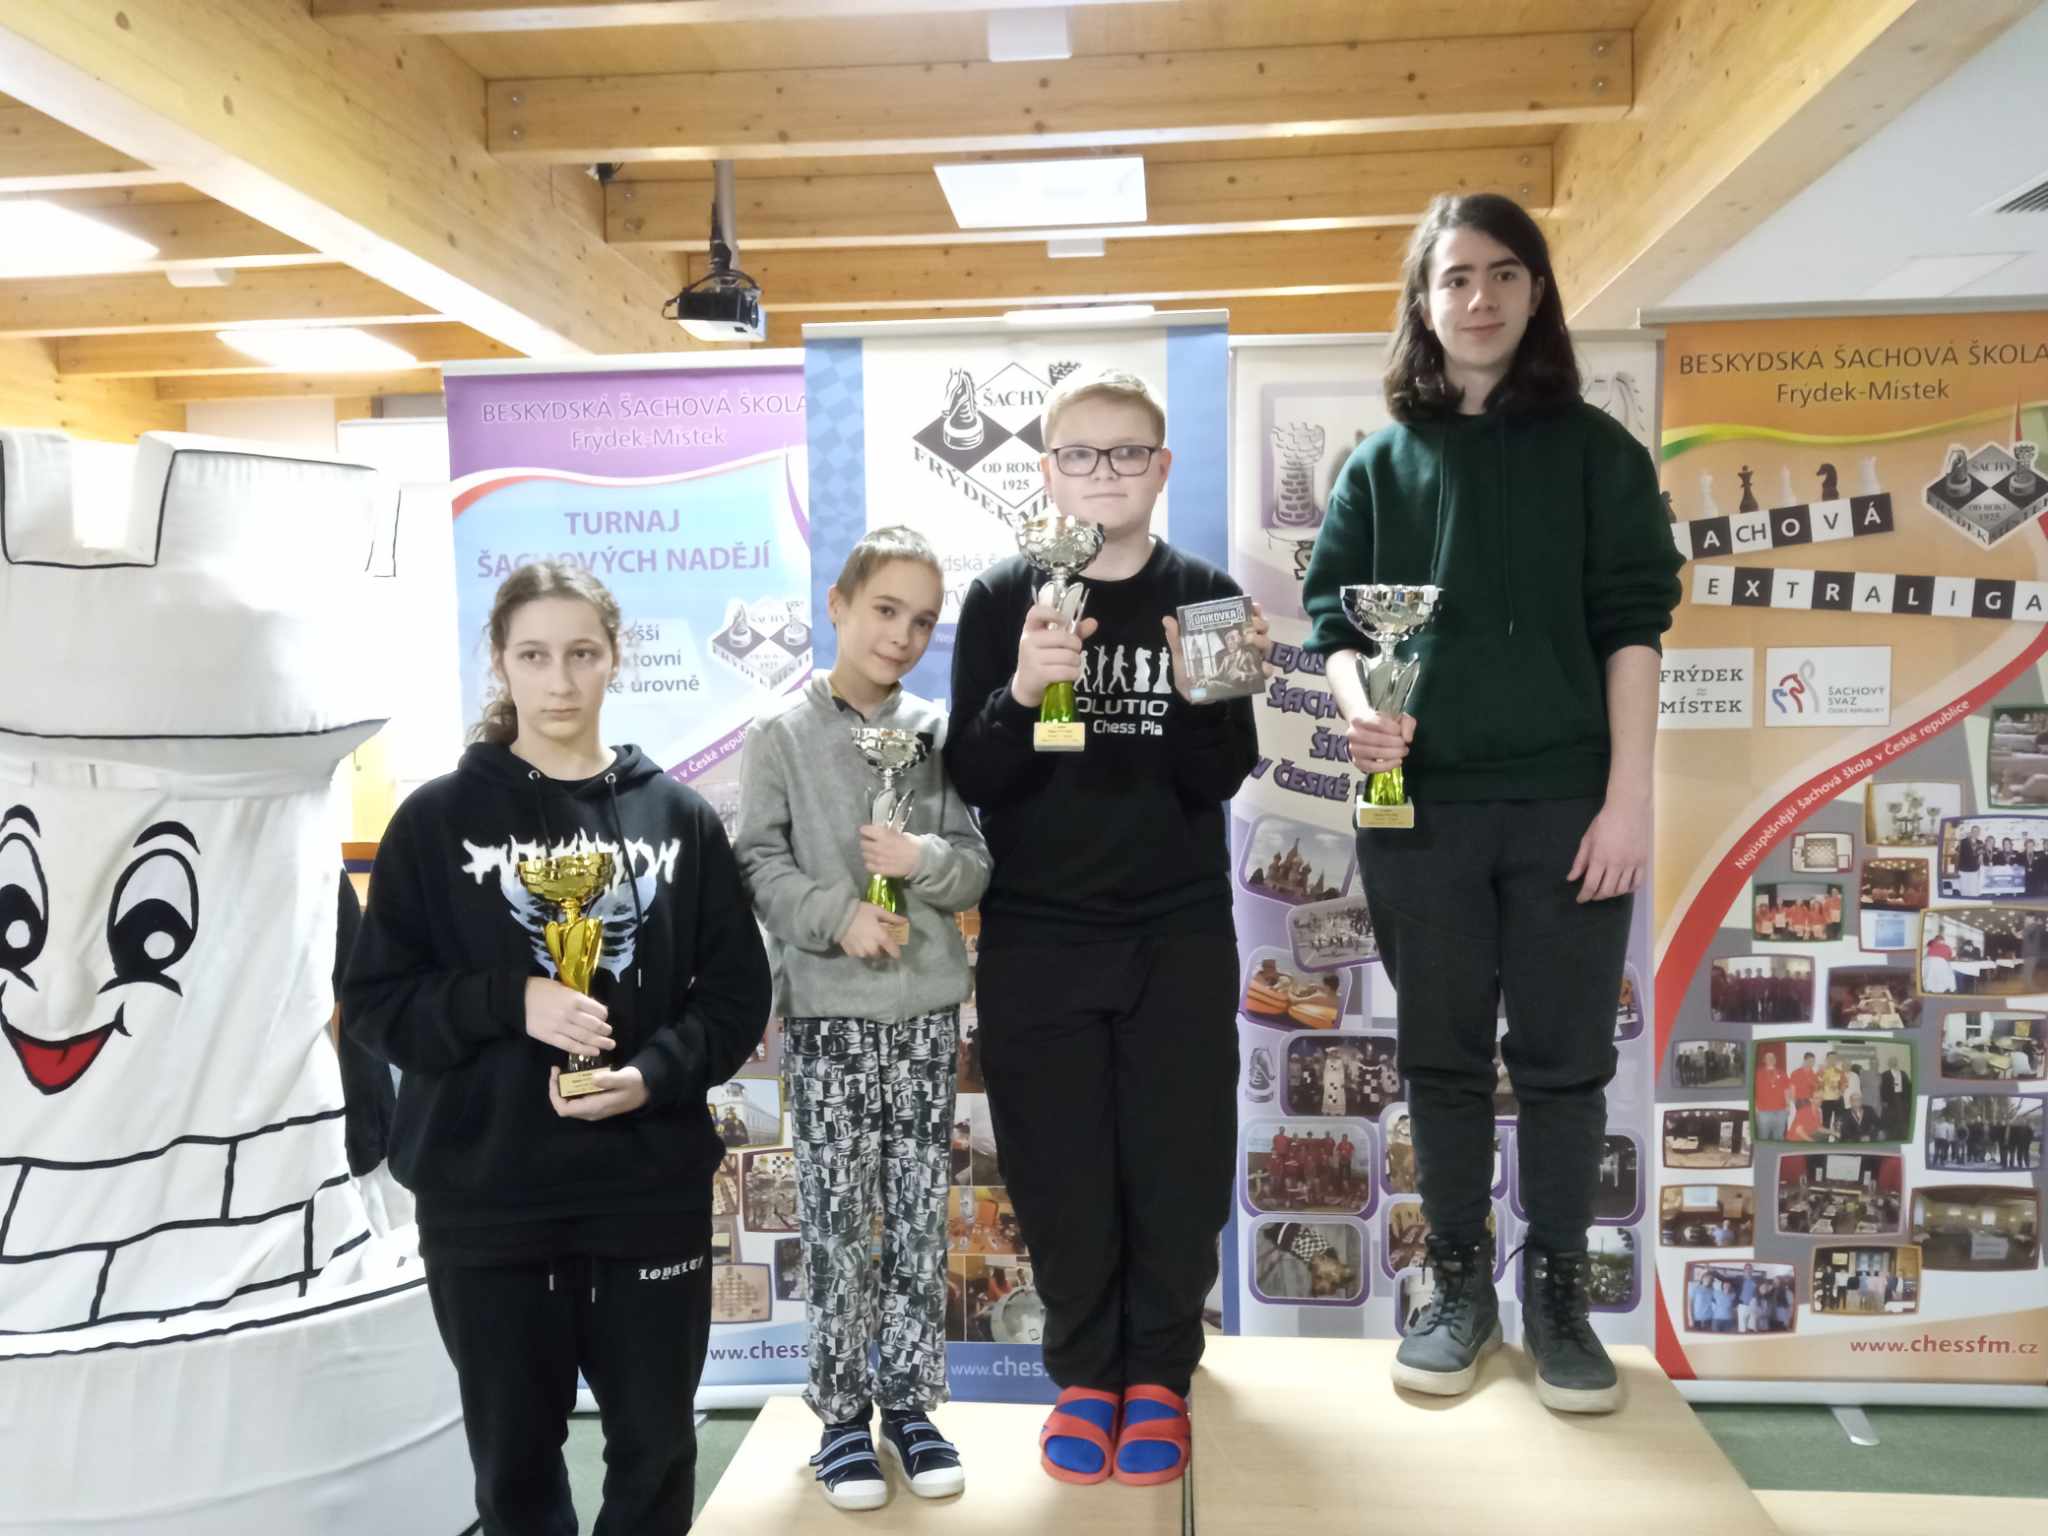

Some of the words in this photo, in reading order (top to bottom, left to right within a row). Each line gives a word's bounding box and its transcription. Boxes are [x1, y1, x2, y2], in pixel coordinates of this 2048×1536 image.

[1679, 347, 1825, 376] BESKYDSKÁ
[1833, 340, 1960, 370] ŠACHOVÁ
[1967, 338, 2048, 366] ŠKOLA
[982, 387, 1048, 408] ŠACHY
[1776, 378, 1951, 409] Frýdek-Místek
[619, 391, 733, 420] ŠACHOVÁ
[982, 462, 1002, 474] OD
[1002, 479, 1030, 491] 1925
[564, 509, 681, 536] TURNAJ
[1703, 502, 1884, 550] ACHOVÁ
[666, 541, 771, 572] NADĚJÍ
[1707, 577, 2044, 613] EXTRALIGA
[1660, 664, 1745, 683] FRÝDEK
[1075, 696, 1169, 717] OLUTIO
[1660, 696, 1743, 714] MÍSTEK
[1827, 696, 1857, 706] SVAZ
[1093, 719, 1137, 735] Chess
[1140, 720, 1164, 736] Pla
[1842, 758, 1874, 781] škola
[1875, 752, 1884, 763] v
[1919, 699, 1971, 738] republice
[1273, 758, 1350, 803] ČESKÉ
[710, 1339, 810, 1361] ww.chess
[1850, 1333, 2040, 1356] www.chessfm.cz
[951, 1354, 1050, 1377] www.ches
